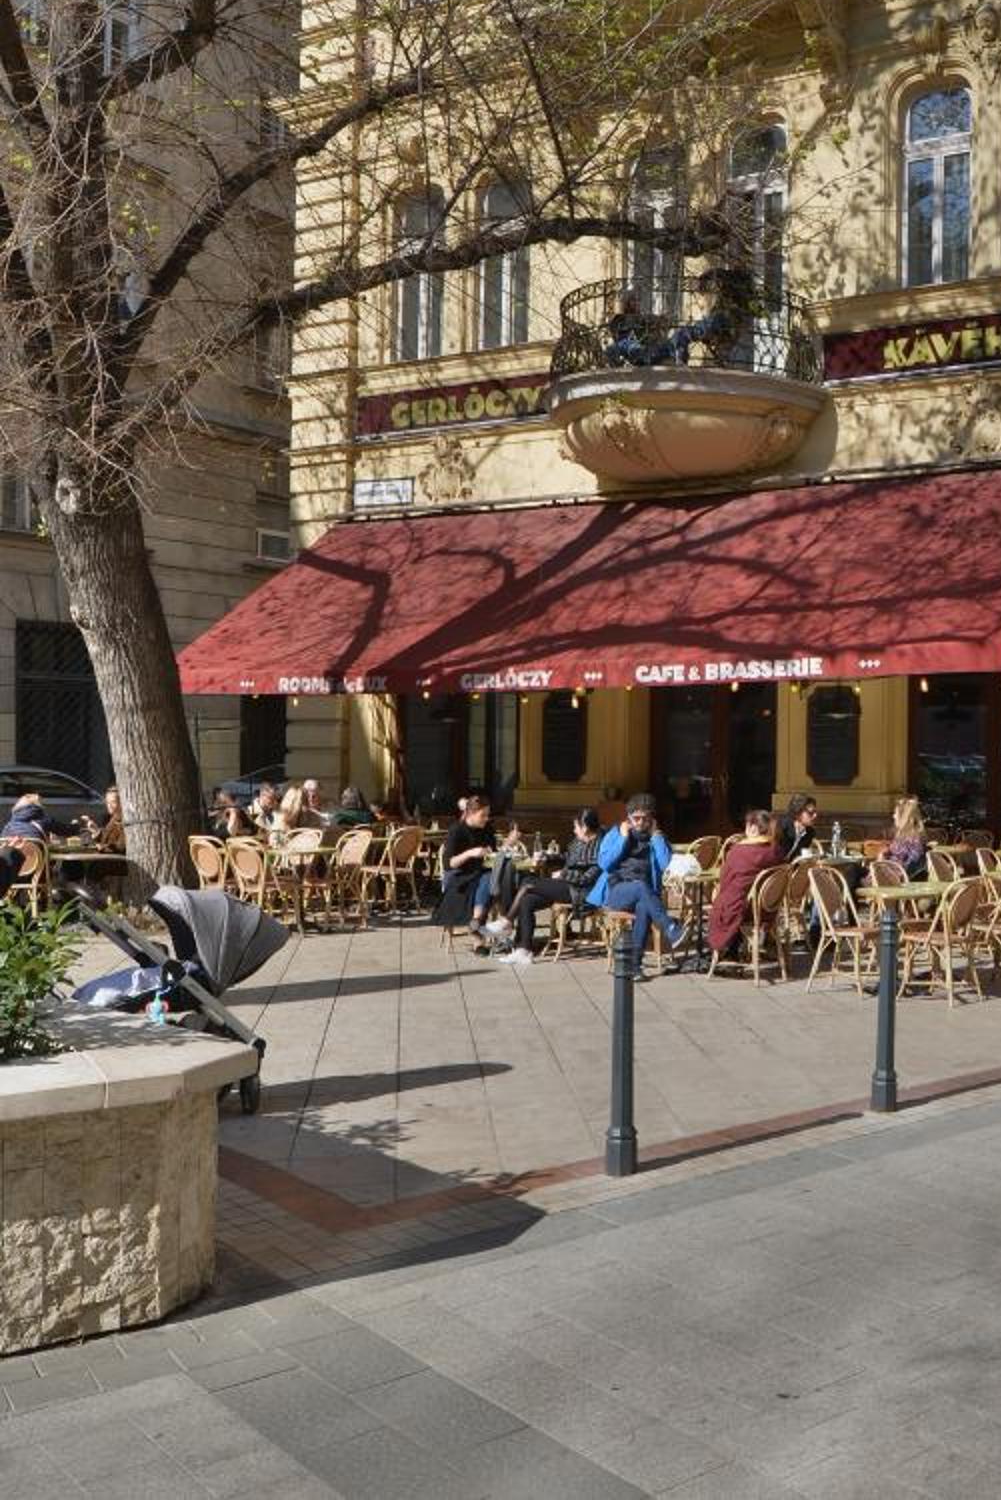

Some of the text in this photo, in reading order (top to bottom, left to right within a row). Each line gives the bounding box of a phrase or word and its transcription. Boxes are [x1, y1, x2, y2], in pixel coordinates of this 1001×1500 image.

[461, 668, 553, 689] GERLÓCZY
[688, 667, 701, 681] &
[705, 657, 823, 679] BRASSERIE
